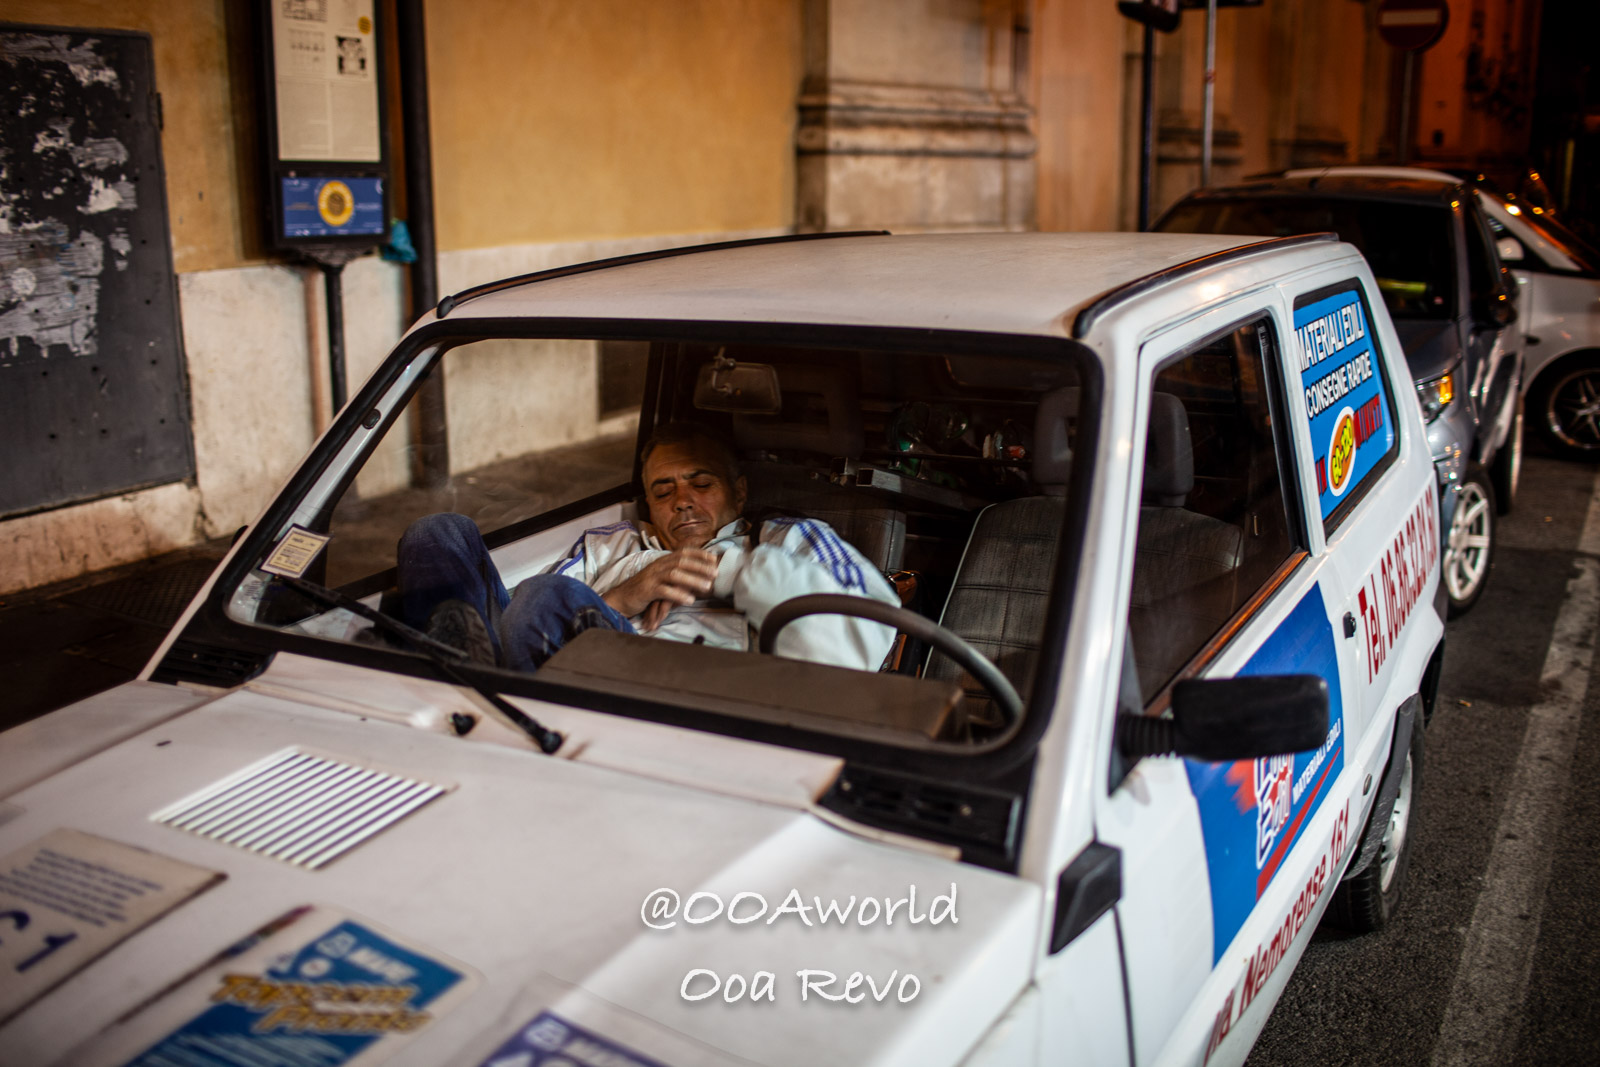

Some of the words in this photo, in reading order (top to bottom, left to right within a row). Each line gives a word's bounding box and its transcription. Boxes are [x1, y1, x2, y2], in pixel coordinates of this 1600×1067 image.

[1294, 308, 1345, 371] MATERIALI
[1341, 301, 1365, 346] EDILI
[1305, 365, 1349, 419] CONSEGNE
[1346, 350, 1373, 391] RAPIDE
[1292, 744, 1327, 805] MATERIALI
[1239, 853, 1327, 1018] Nemorense
[1330, 797, 1350, 875] 161
